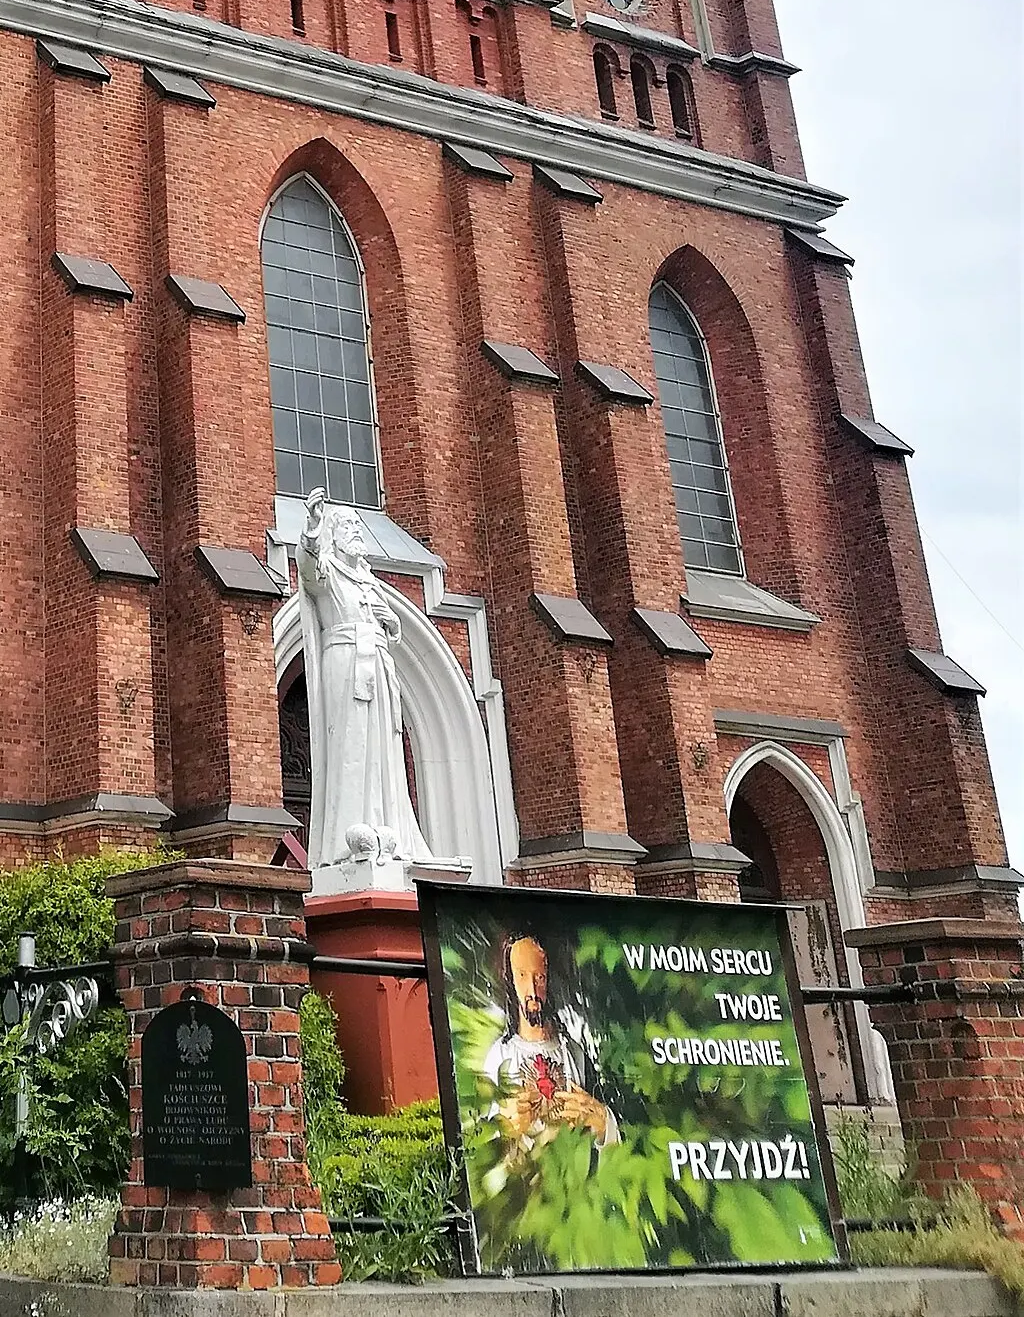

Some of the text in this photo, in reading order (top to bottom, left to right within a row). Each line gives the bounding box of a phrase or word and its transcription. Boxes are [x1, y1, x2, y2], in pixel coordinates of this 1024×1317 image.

[622, 943, 773, 977] W MOIM SERCU
[714, 993, 783, 1022] TWOJE
[652, 1038, 791, 1067] SCHRONIENIE.
[667, 1134, 811, 1182] PRZYJDŹ!
